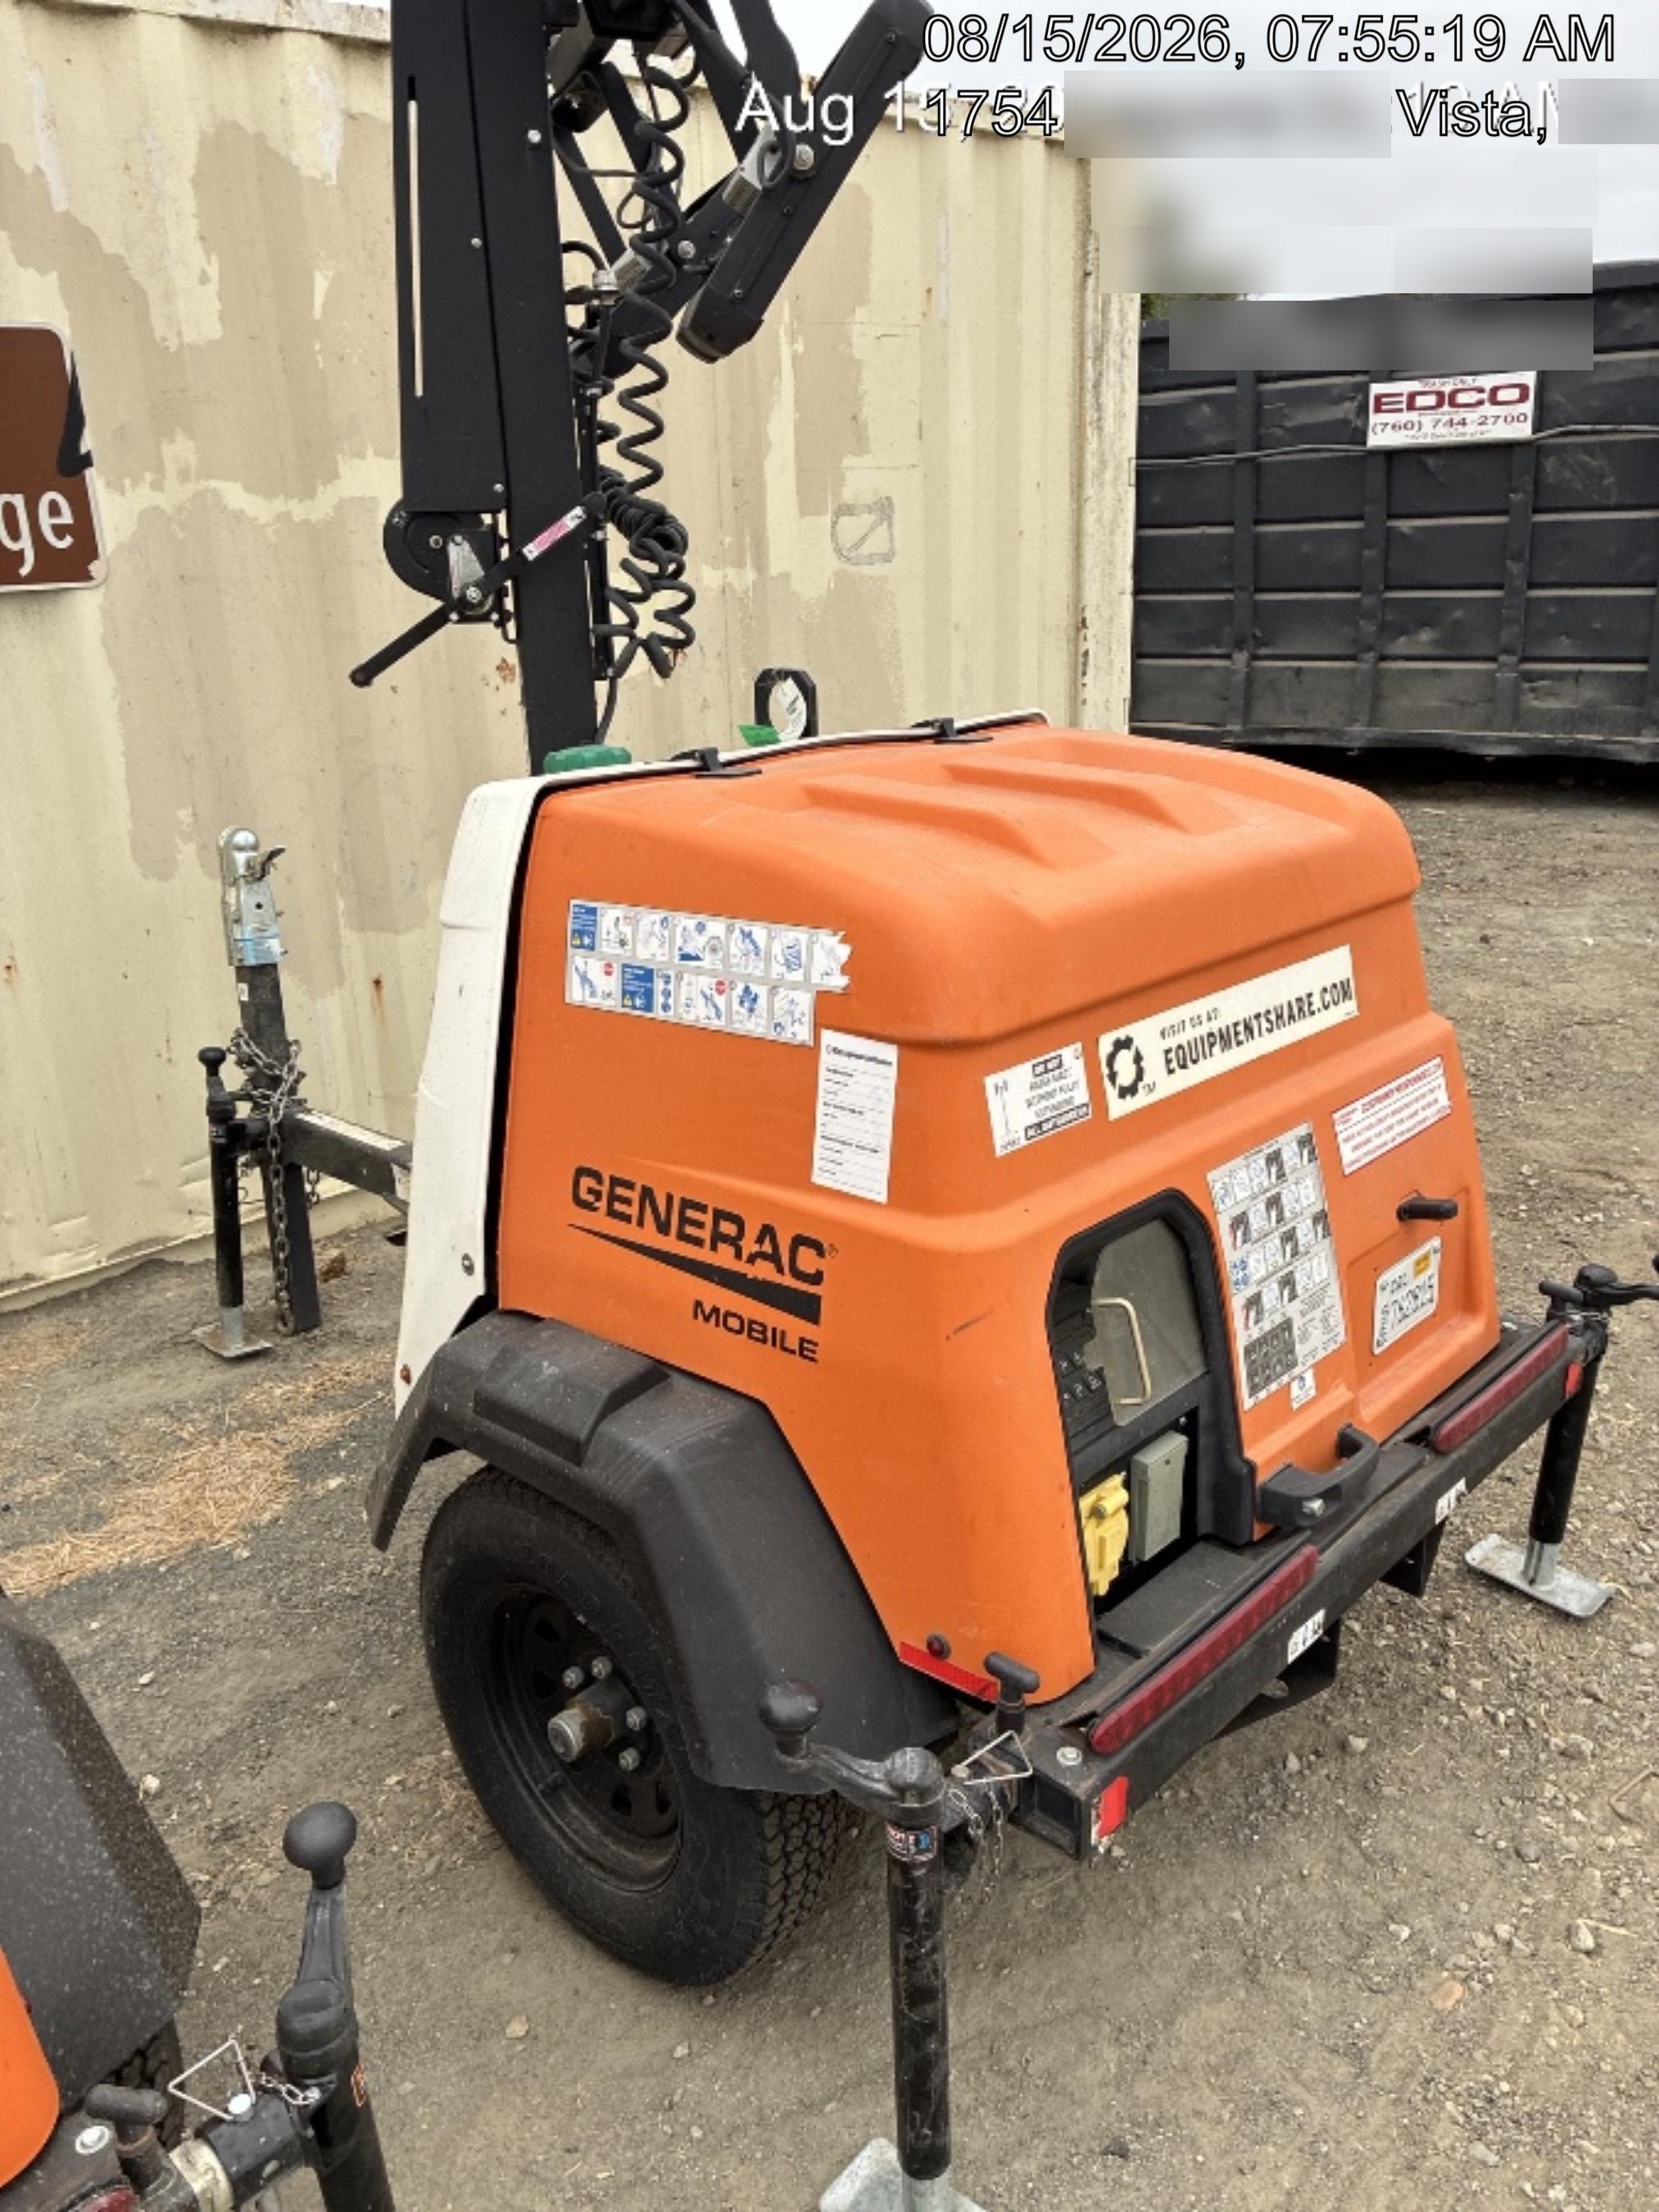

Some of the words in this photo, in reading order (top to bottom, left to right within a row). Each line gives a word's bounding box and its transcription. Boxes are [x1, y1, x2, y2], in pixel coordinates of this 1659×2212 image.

[1374, 383, 1530, 414] EDCO
[1372, 419, 1422, 436] (760)
[1431, 414, 1528, 429] 744-2700
[1159, 1019, 1185, 1040] VISIT
[1163, 977, 1353, 1076] EQUIPMENTSHARE.COM
[571, 1164, 826, 1286] GENERAC
[691, 1299, 819, 1363] MOBILE
